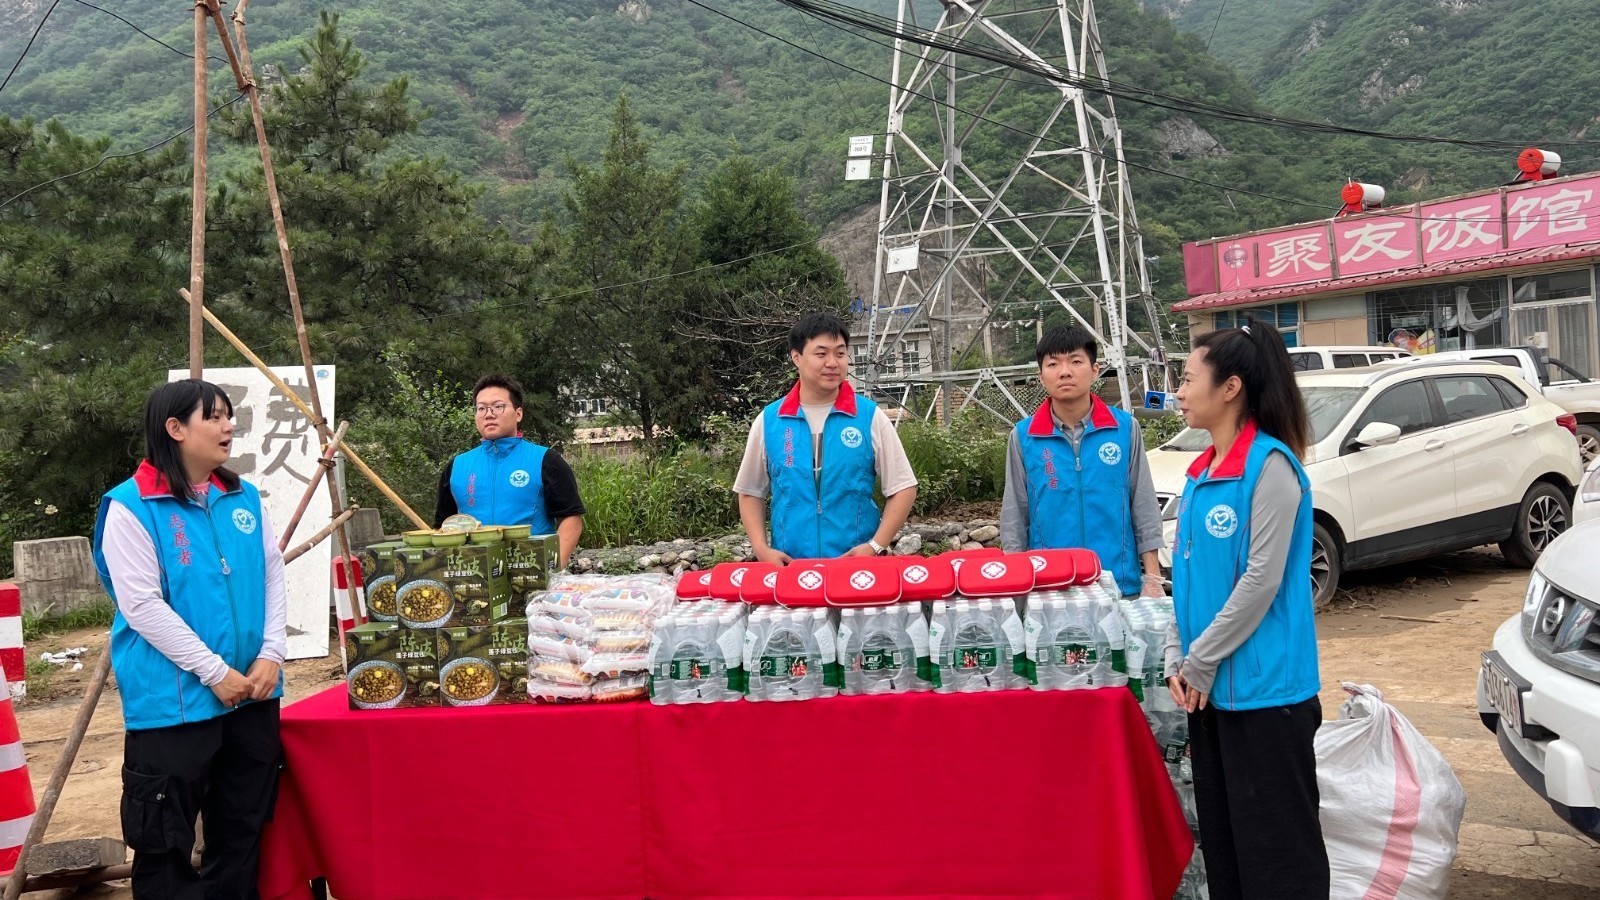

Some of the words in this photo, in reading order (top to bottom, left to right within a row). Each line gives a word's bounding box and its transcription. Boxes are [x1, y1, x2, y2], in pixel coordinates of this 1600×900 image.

[1265, 188, 1594, 278] 聚友饭馆
[169, 513, 192, 566] 志愿者
[447, 551, 484, 579] 陈皮
[399, 632, 436, 660] 陈皮
